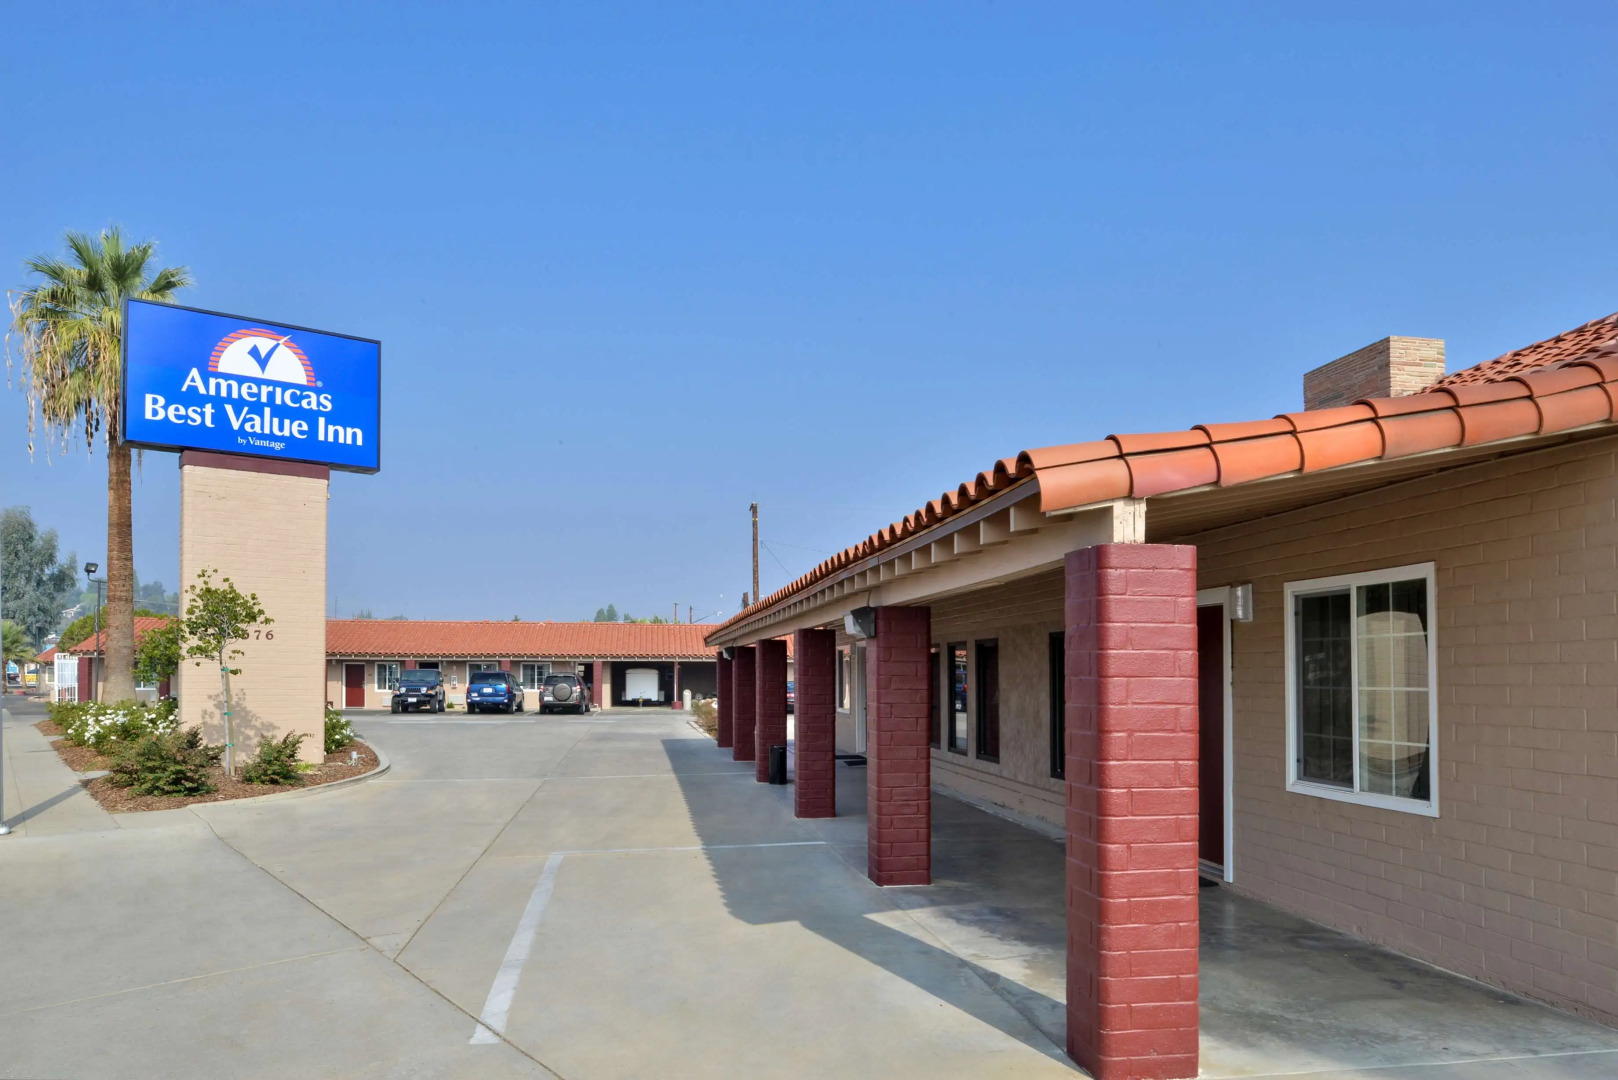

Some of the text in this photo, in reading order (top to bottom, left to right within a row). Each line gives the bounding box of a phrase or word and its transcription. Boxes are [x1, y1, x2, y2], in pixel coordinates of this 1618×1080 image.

[181, 367, 333, 412] Americas
[144, 393, 363, 446] Best Value Inn
[237, 436, 286, 451] by Vantage
